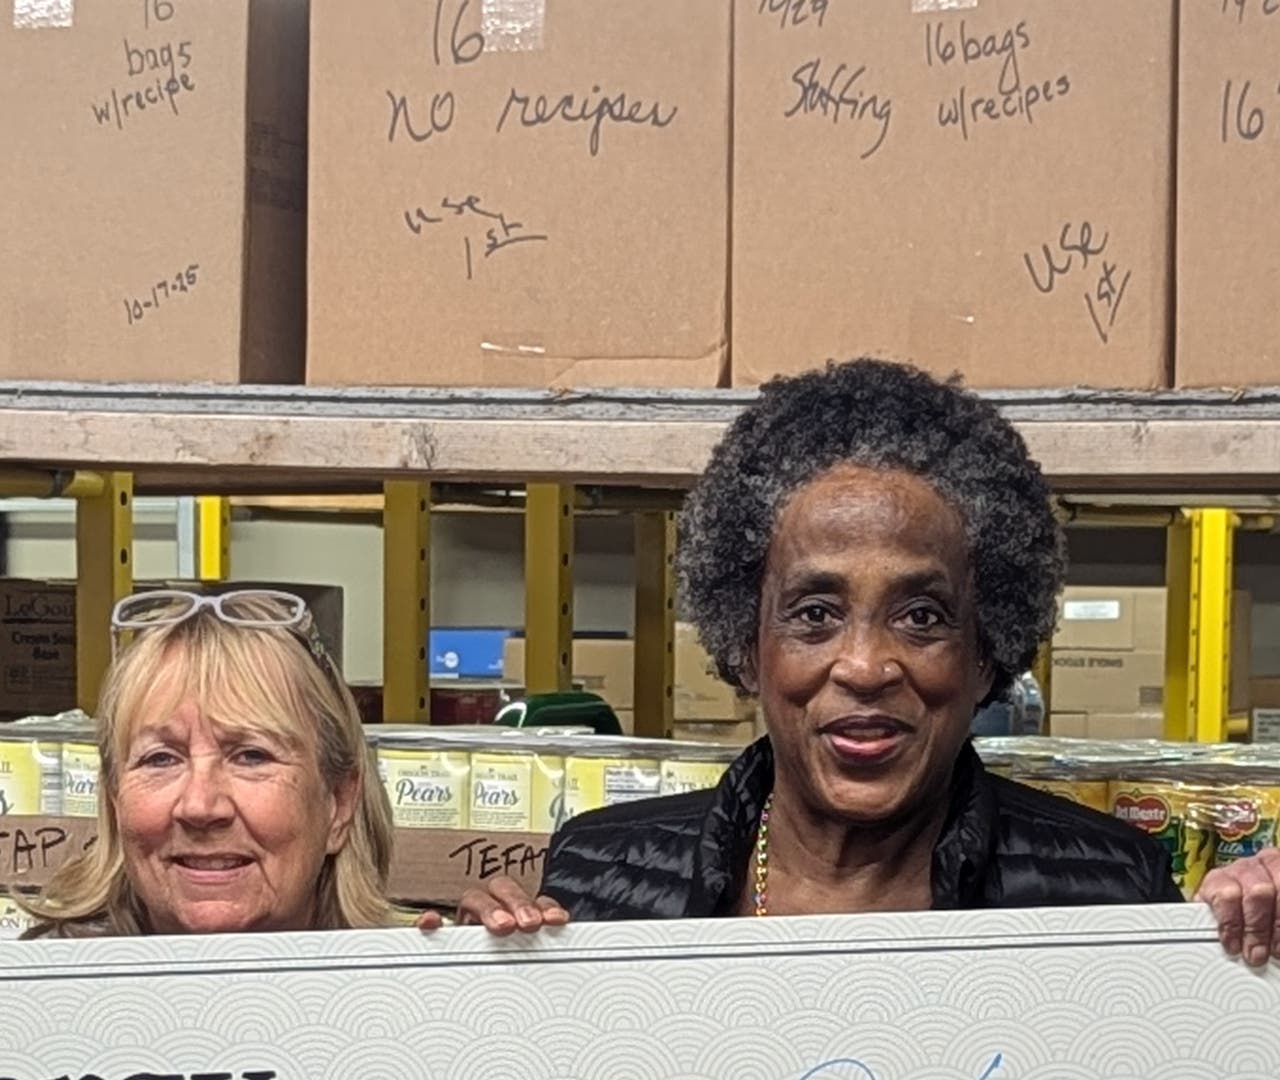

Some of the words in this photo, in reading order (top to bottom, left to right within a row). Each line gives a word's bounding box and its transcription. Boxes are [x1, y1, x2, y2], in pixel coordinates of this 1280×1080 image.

[124, 39, 193, 80] bags
[433, 0, 485, 65] 16
[926, 21, 957, 66] 16
[961, 20, 1031, 96] bags
[93, 72, 196, 129] w/recipe
[938, 74, 1071, 141] w/recipes
[1221, 80, 1265, 142] 16
[395, 777, 453, 806] Pears
